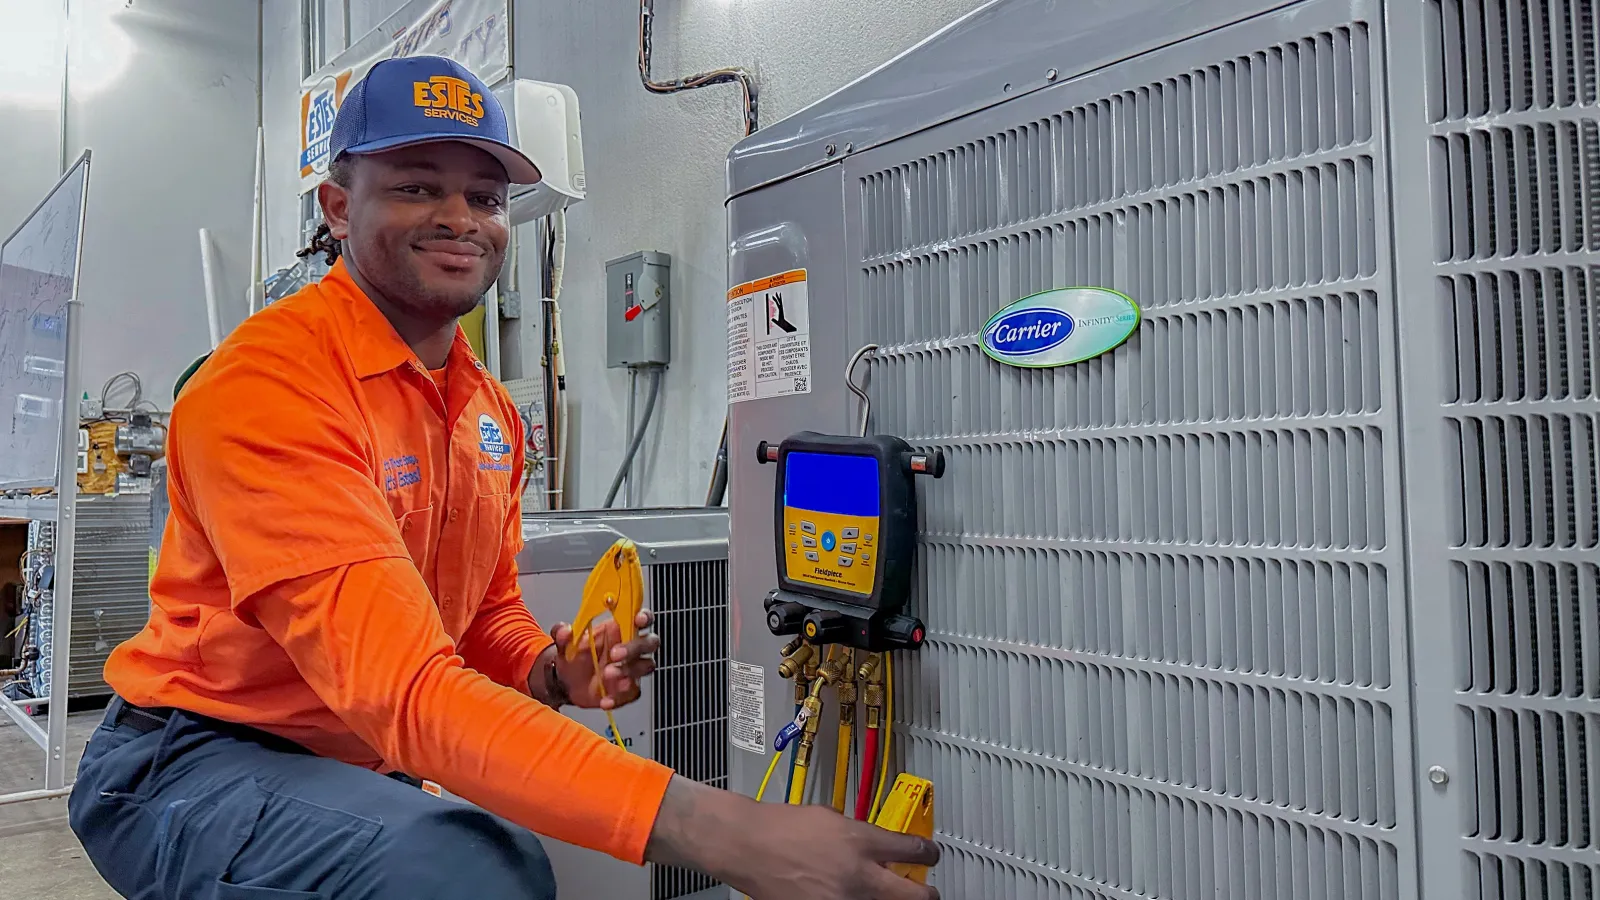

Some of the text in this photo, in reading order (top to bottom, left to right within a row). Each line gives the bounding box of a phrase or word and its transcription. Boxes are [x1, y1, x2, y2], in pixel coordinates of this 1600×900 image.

[413, 76, 485, 119] ESTES
[308, 89, 336, 143] ESTES
[424, 108, 479, 127] SERVICES
[306, 135, 330, 163] SERVIC
[995, 320, 1062, 344] Carrier
[1078, 316, 1111, 328] INFINITY
[814, 567, 843, 578] Fieldpiece
